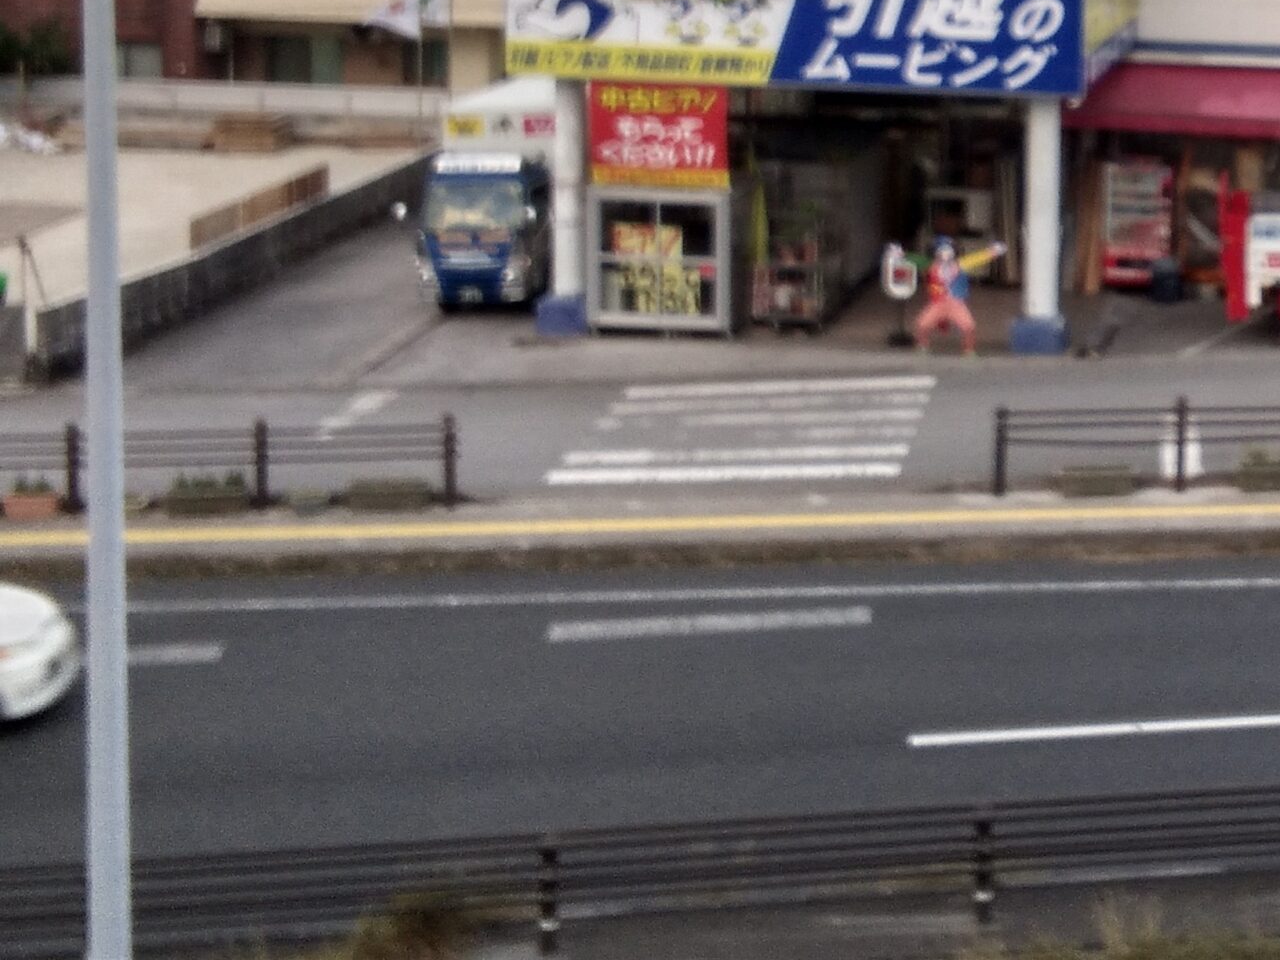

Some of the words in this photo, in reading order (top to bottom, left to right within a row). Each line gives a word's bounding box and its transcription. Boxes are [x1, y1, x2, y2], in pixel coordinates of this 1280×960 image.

[802, 38, 1058, 90] ムービング
[600, 85, 718, 114] 中古ピアノ
